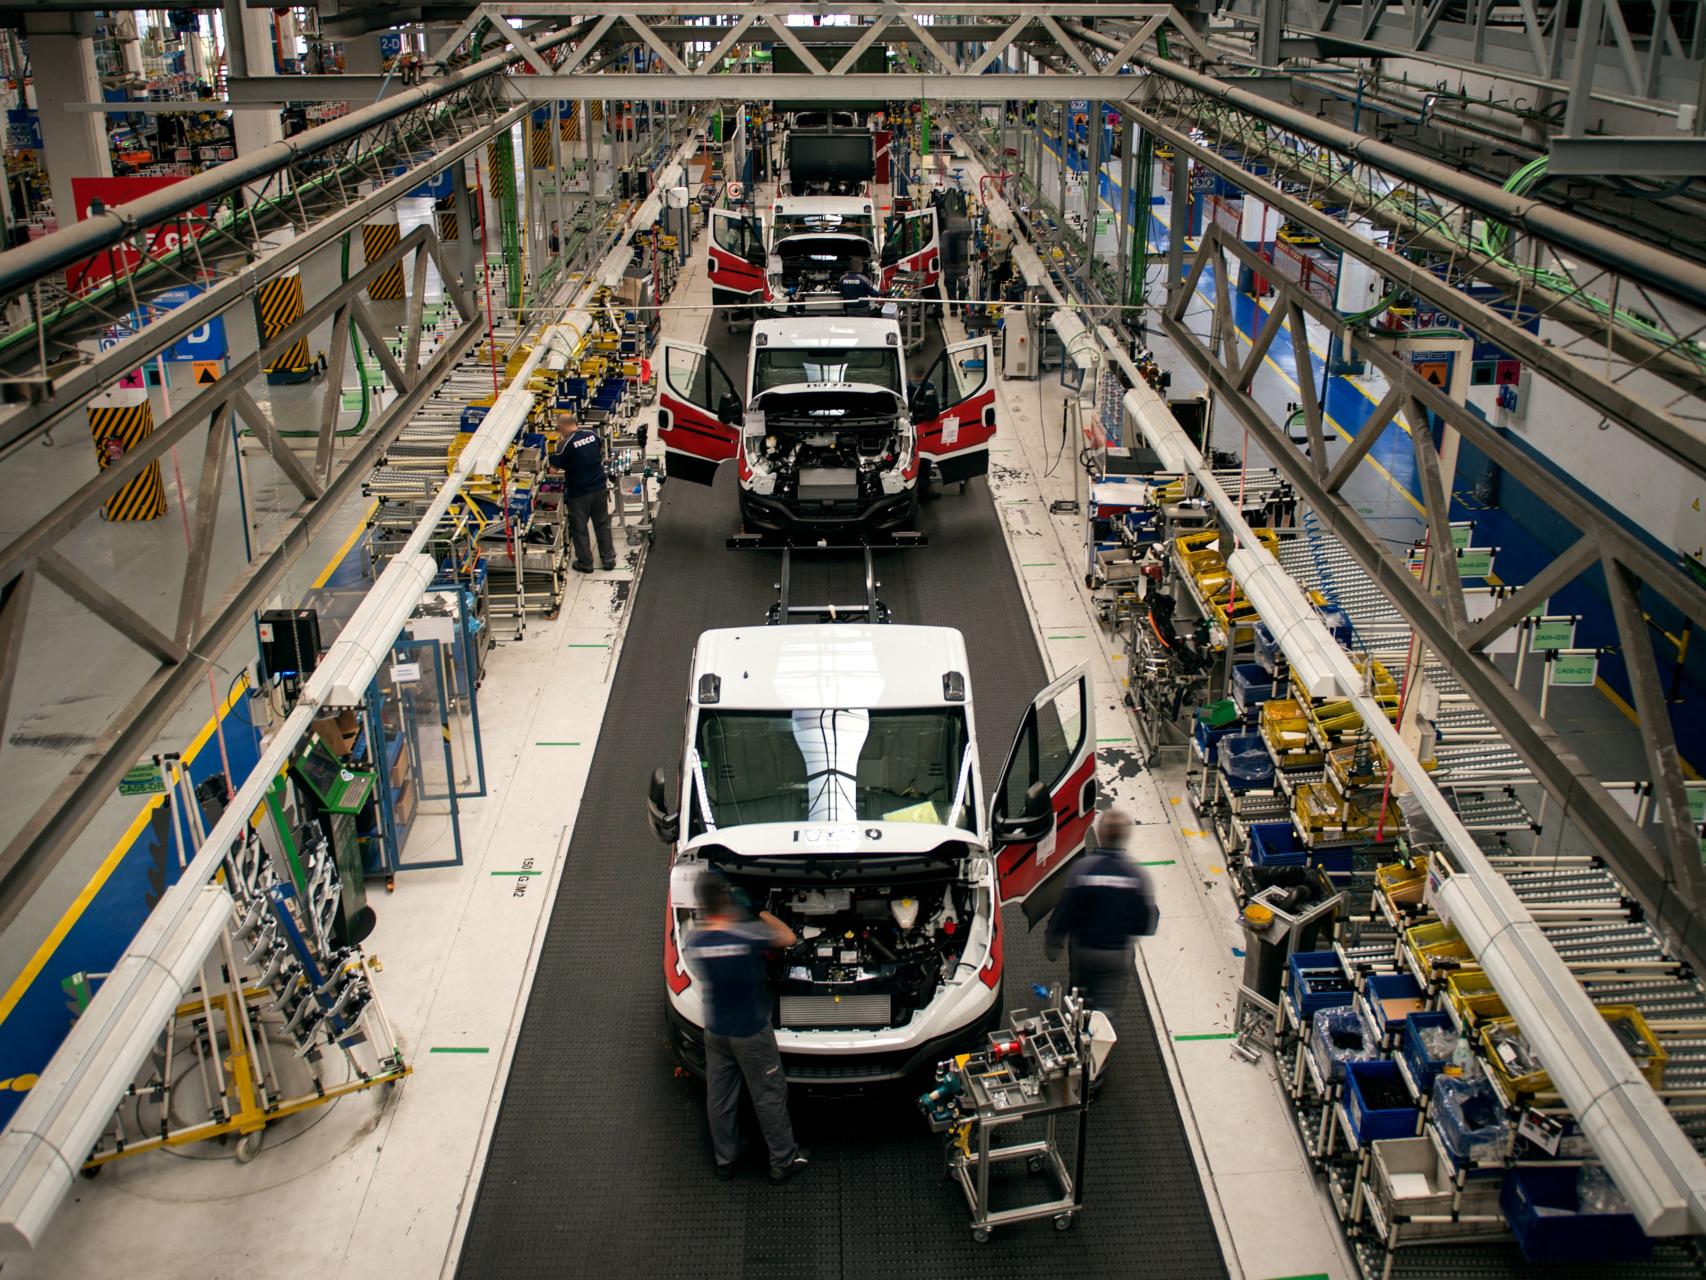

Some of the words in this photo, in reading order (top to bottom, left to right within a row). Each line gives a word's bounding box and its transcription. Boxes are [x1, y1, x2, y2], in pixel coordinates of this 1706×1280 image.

[381, 38, 400, 49] 2-D
[573, 434, 596, 449] IVECO
[792, 828, 883, 843] IVO
[512, 870, 531, 898] G/M2
